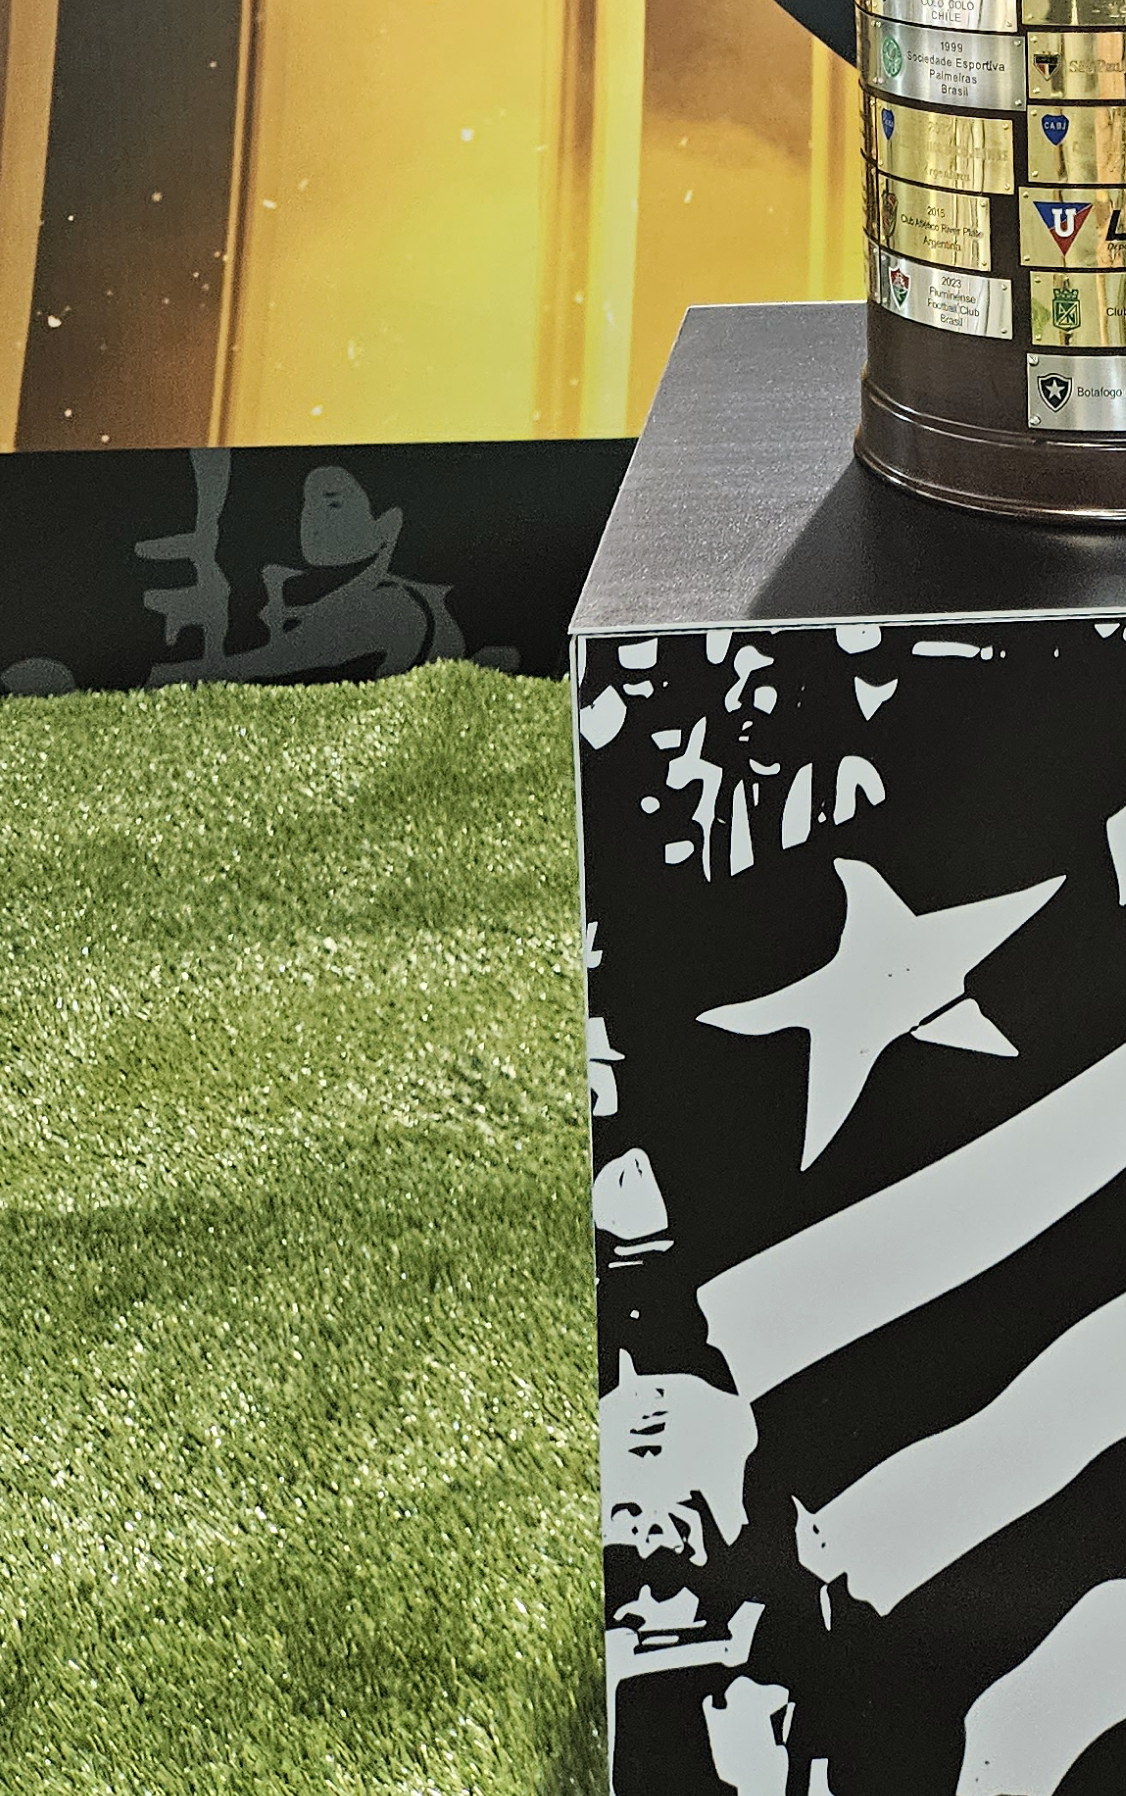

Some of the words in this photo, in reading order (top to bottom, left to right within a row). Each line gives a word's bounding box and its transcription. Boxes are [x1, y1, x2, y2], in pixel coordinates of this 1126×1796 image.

[948, 0, 975, 11] COLO
[931, 10, 962, 23] CHILE
[940, 41, 963, 53] 1999
[906, 50, 952, 67] Sociedade
[955, 57, 1006, 72] Esportiva
[929, 68, 978, 85] Palmeiras
[941, 84, 969, 97] Brasil
[926, 206, 946, 218] 2015
[900, 213, 915, 226] Club
[1051, 208, 1077, 238] U
[922, 235, 962, 252] Argentina
[941, 276, 962, 289] 2023
[929, 286, 977, 304] Fluminense
[959, 304, 980, 317] Club
[940, 313, 963, 327] Brasil
[1077, 386, 1123, 399] Botafogo
